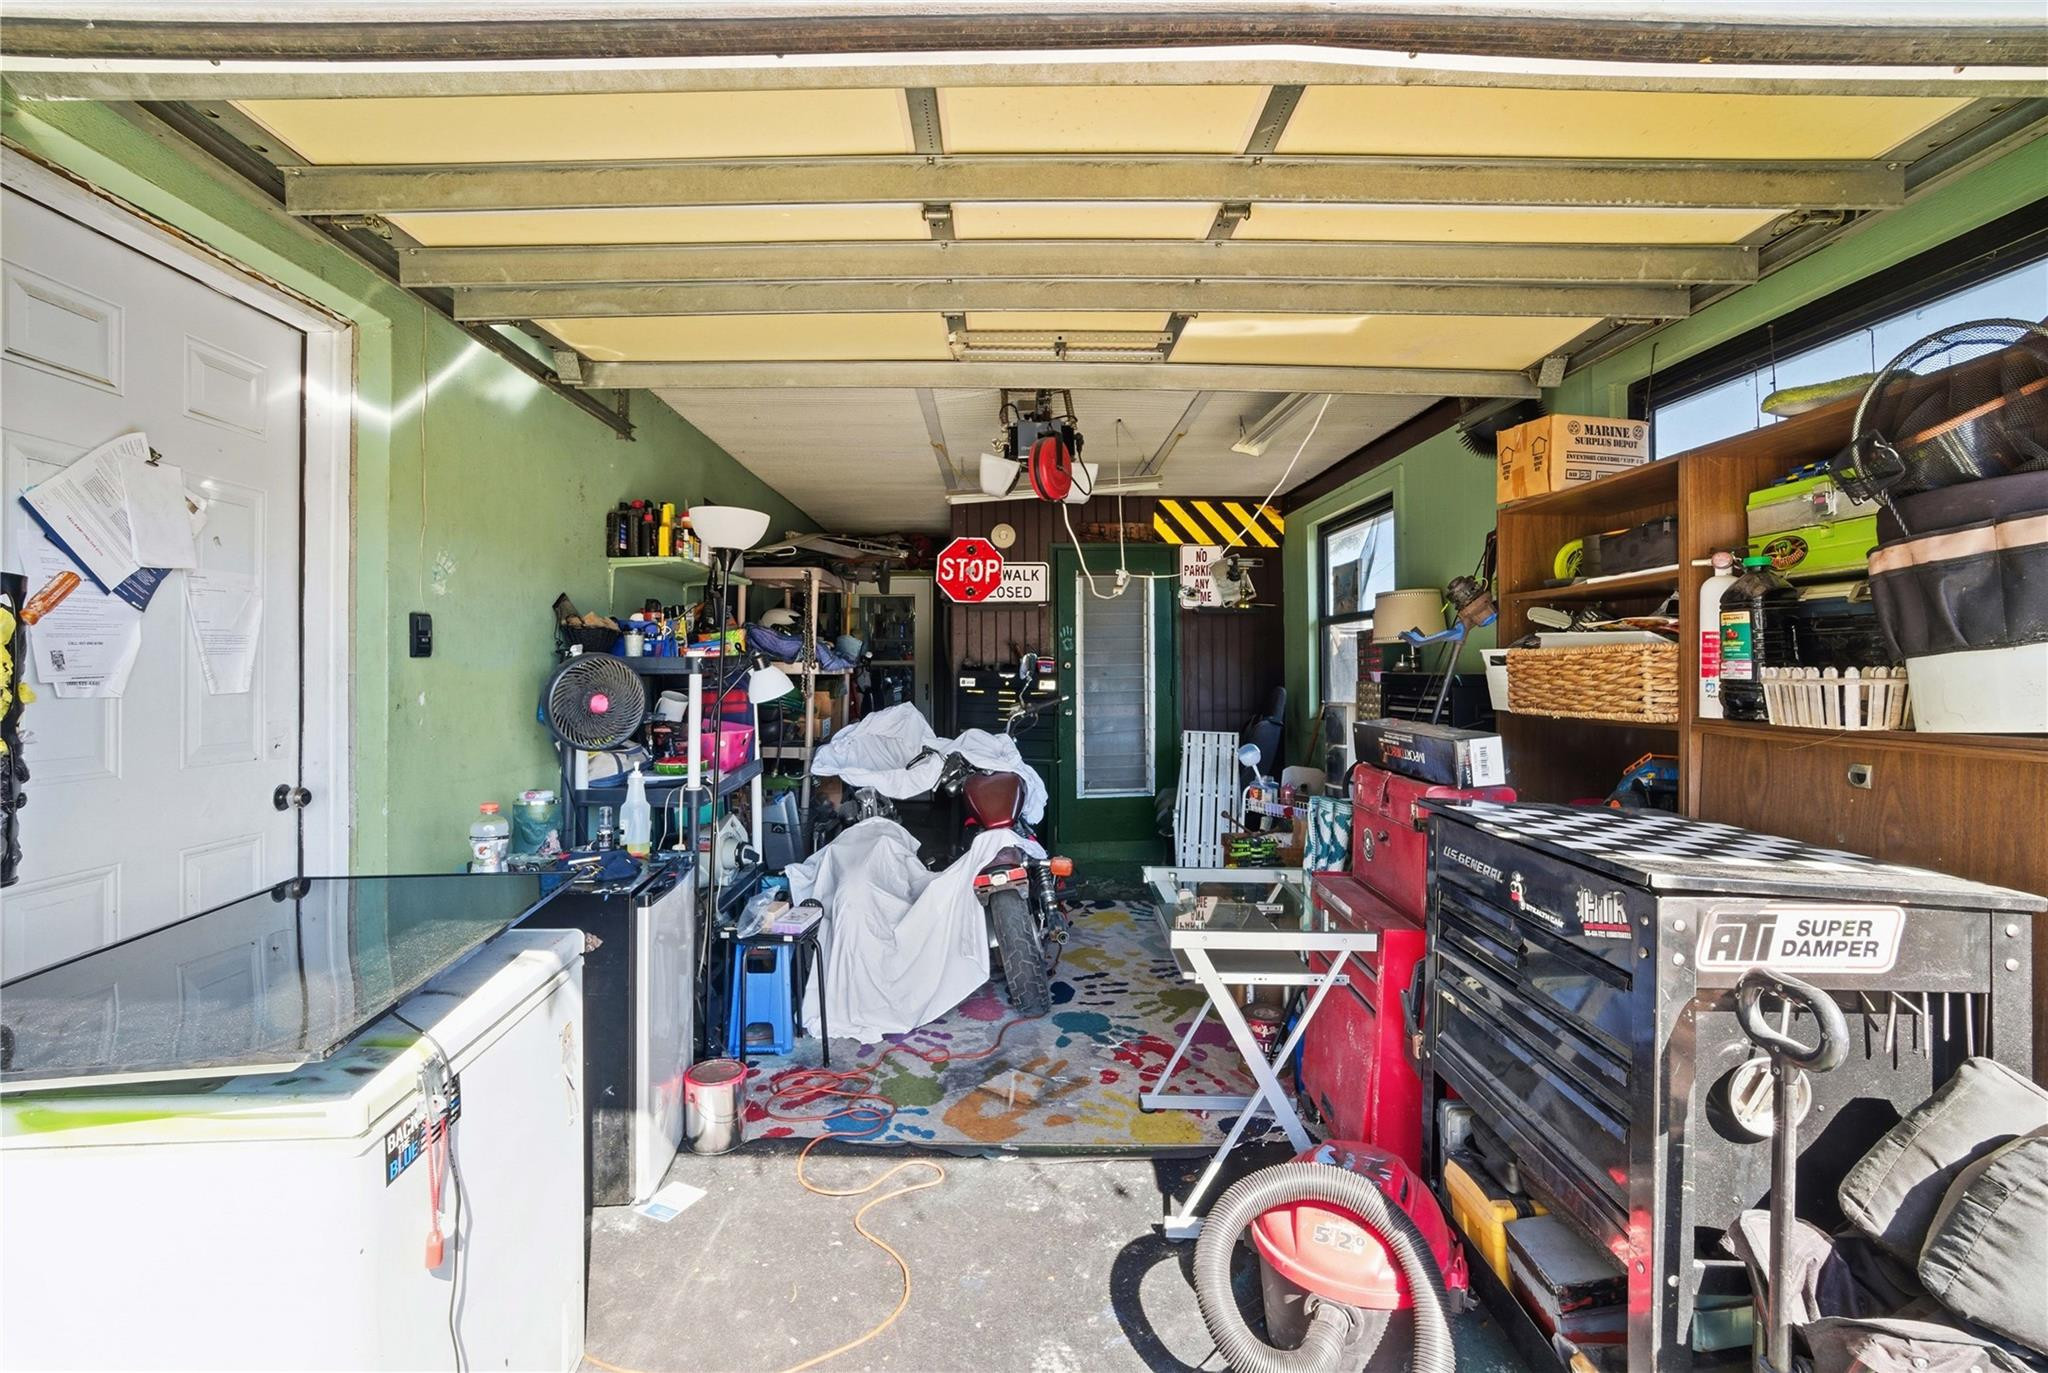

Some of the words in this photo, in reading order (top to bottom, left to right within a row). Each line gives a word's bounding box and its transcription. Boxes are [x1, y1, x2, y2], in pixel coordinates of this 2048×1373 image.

[1584, 424, 1630, 438] MARINE
[1574, 436, 1612, 447] SURPLUS
[1613, 439, 1638, 449] DEPOT
[1196, 550, 1208, 563] NO
[941, 557, 1000, 584] STOP
[1003, 569, 1040, 582] WALK
[1184, 564, 1212, 577] PARKI
[1194, 578, 1210, 589] ANY
[989, 586, 1032, 599] OSED
[1200, 591, 1212, 602] ME
[1795, 919, 1873, 937] SUPER
[1780, 939, 1880, 958] DAMPER
[390, 1139, 418, 1181] BLUE
